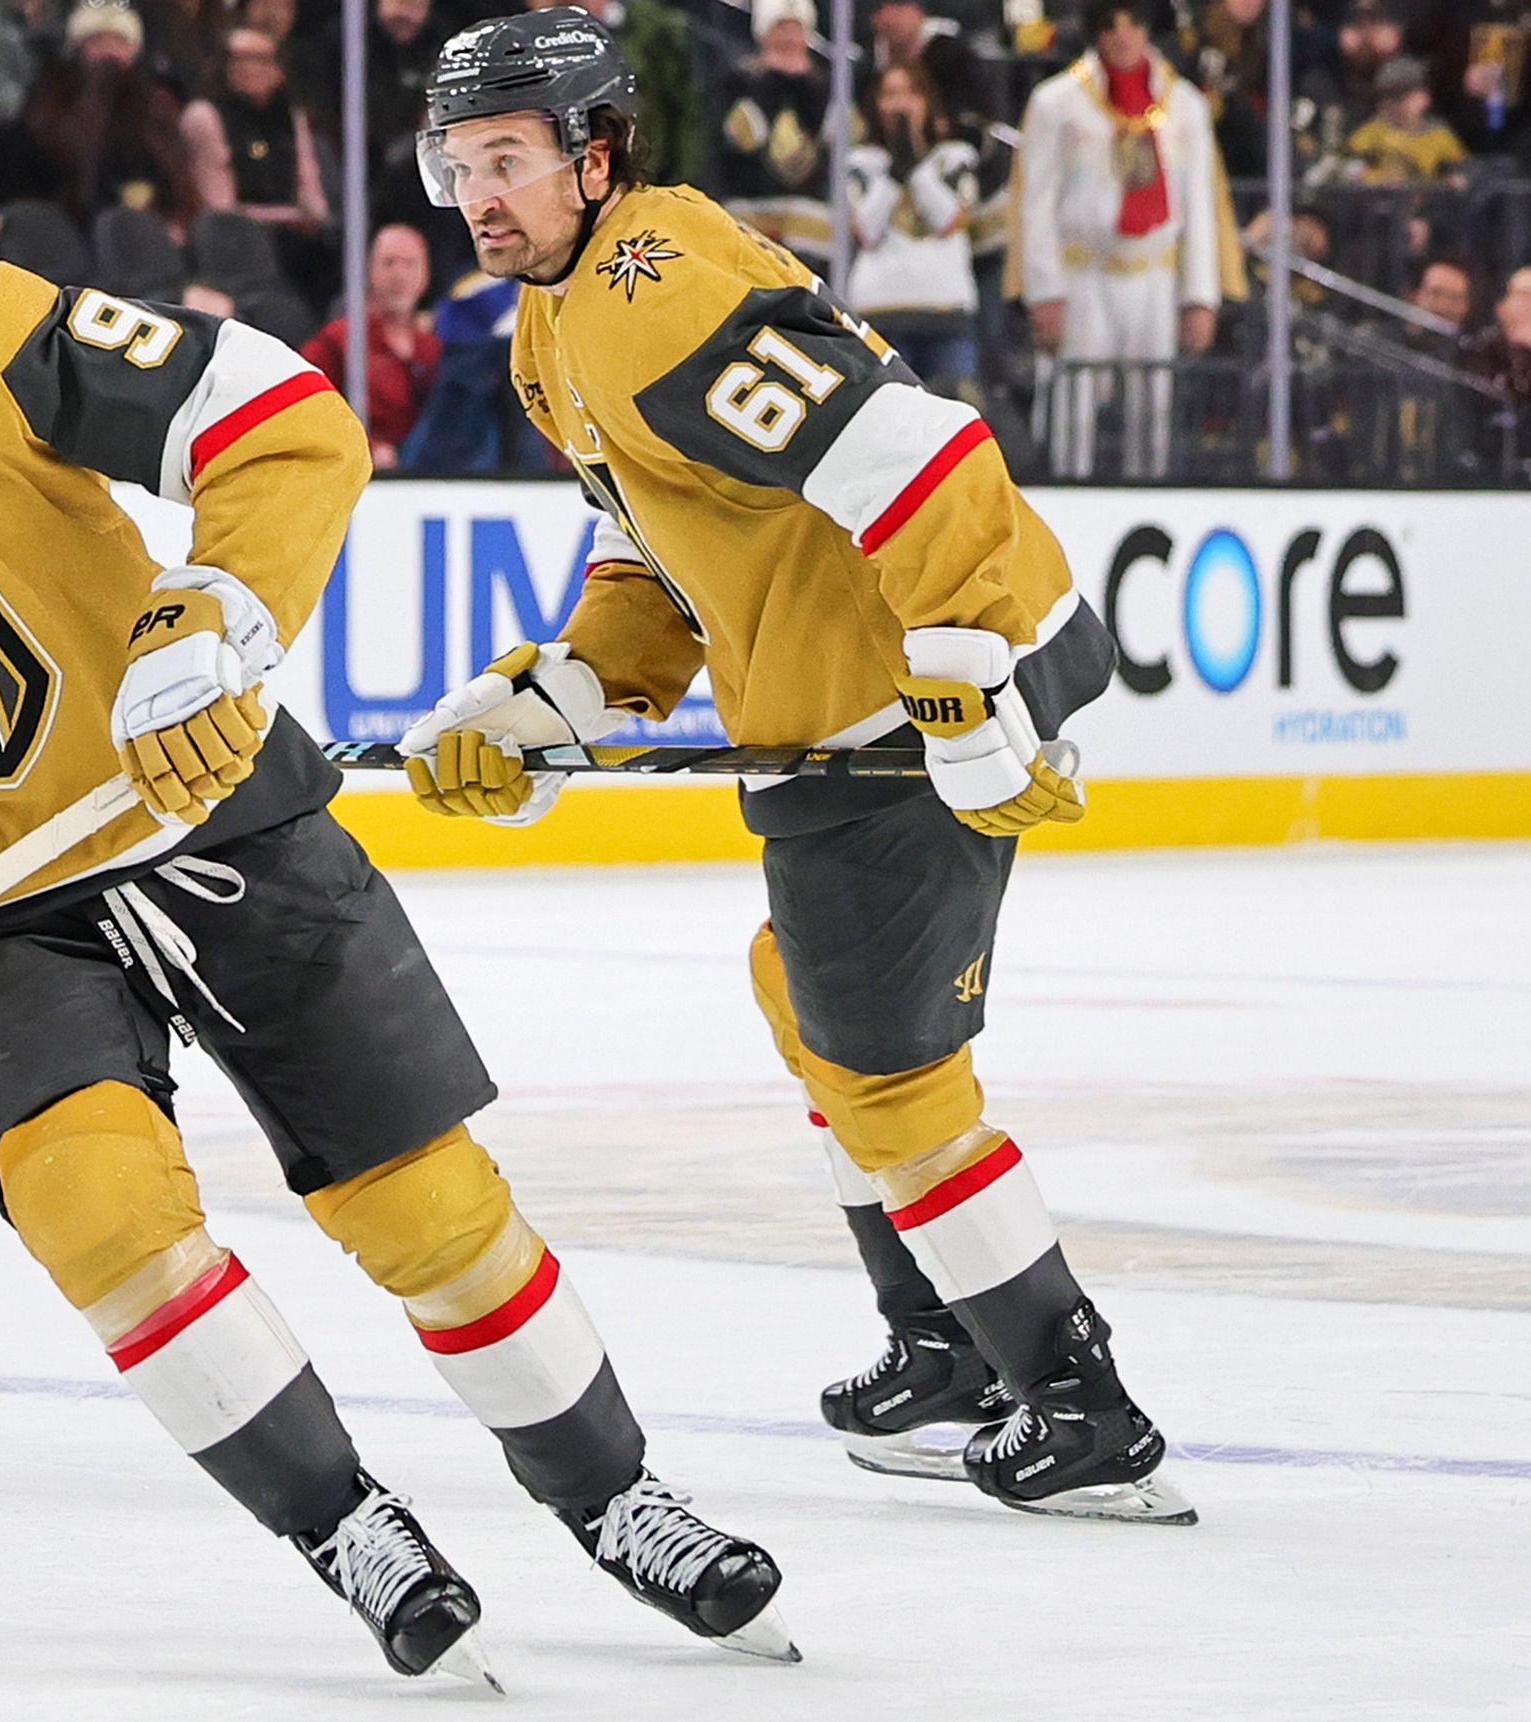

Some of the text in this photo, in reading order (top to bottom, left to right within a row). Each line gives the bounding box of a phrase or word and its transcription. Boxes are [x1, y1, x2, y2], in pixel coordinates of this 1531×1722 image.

[534, 30, 598, 49] CreditOne
[704, 324, 846, 453] 61
[1105, 524, 1405, 695] core
[97, 918, 134, 970] BAUER
[872, 1389, 913, 1416] BAUER
[1016, 1455, 1056, 1482] BAUER
